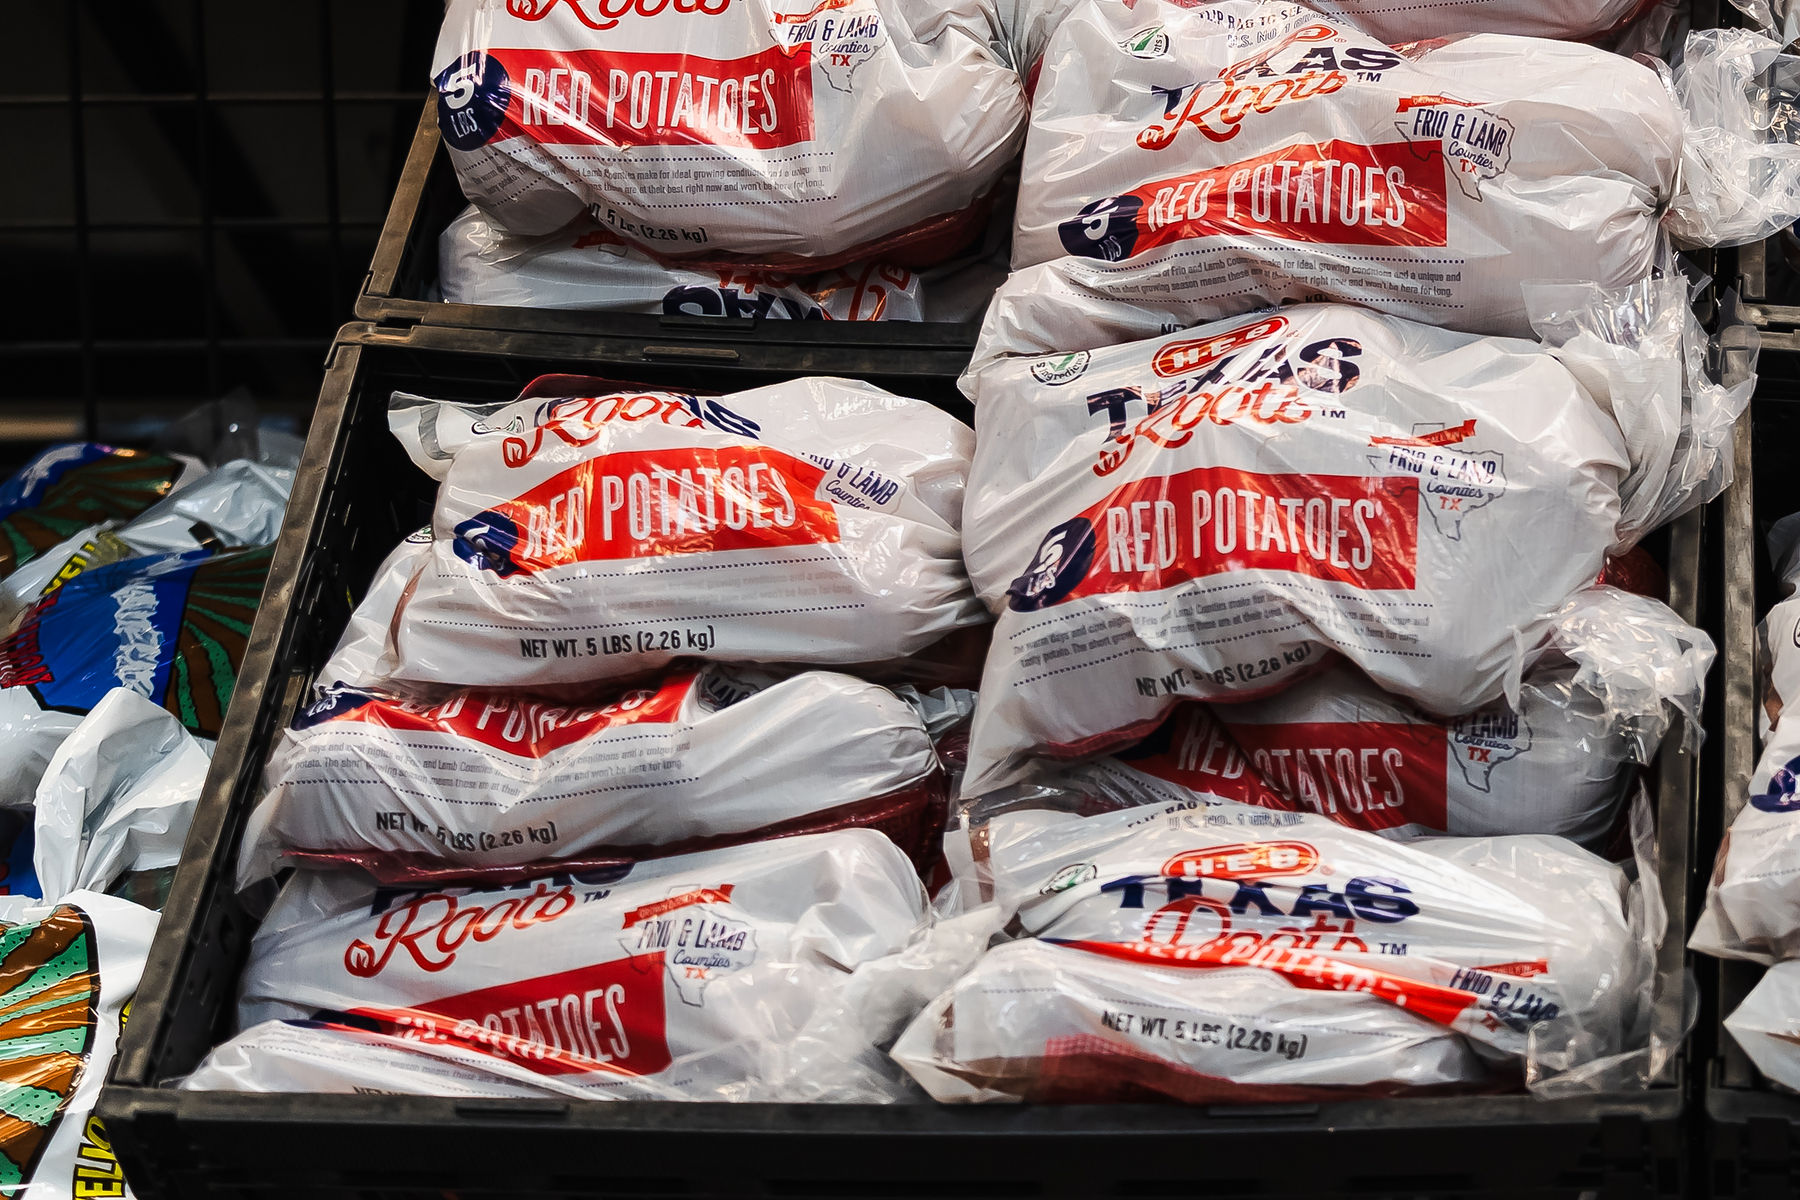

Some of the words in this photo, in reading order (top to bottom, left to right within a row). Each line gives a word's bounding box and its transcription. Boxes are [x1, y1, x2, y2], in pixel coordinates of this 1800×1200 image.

[788, 21, 817, 45] FRIO
[837, 15, 879, 41] LAMB
[818, 40, 871, 56] Counties
[830, 54, 852, 68] TX
[443, 63, 485, 110] 5
[522, 69, 592, 127] RED
[606, 69, 777, 136] POTATOES
[452, 108, 480, 139] LBS
[1137, 69, 1349, 150] Roots
[1412, 107, 1447, 139] FRIO
[1452, 115, 1466, 137] &
[1469, 118, 1509, 154] LAMB
[637, 170, 658, 180] make
[694, 168, 724, 181] growing
[1448, 140, 1496, 170] Counties
[1459, 158, 1478, 175] TX
[1148, 185, 1209, 233] RED
[1226, 159, 1406, 229] POTATOES
[607, 209, 617, 225] 5
[640, 222, 679, 242] (2.26
[681, 226, 706, 244] kg)
[1091, 380, 1314, 478] Roots
[1388, 444, 1427, 474] FRIO
[846, 468, 900, 507] LAMB
[1439, 496, 1461, 512] TX
[523, 486, 586, 559] RED
[602, 462, 796, 542] POTATOES
[1106, 501, 1178, 574] RED
[1191, 486, 1376, 574] POTATOES
[520, 638, 548, 659] NET
[552, 638, 582, 658] WT.
[586, 636, 598, 656] 5
[602, 632, 632, 655] LBS
[636, 628, 681, 654] (2.26
[684, 625, 716, 652] kg)
[1162, 670, 1190, 695] WT.
[1238, 656, 1282, 683] (2.26
[1284, 641, 1311, 665] kg)
[1176, 723, 1244, 780] RED
[1467, 747, 1493, 763] TX
[376, 812, 408, 831] NET
[479, 830, 523, 852] (2.26
[528, 821, 558, 844] kg)
[1101, 874, 1420, 925] TEXAS
[344, 880, 576, 979] Roots
[693, 920, 748, 952] LAMB
[673, 951, 732, 971] Counties
[1101, 1010, 1134, 1033] NET
[1141, 1016, 1170, 1040] WT.
[1226, 1025, 1272, 1054] (2.26
[1276, 1032, 1309, 1060] kg)
